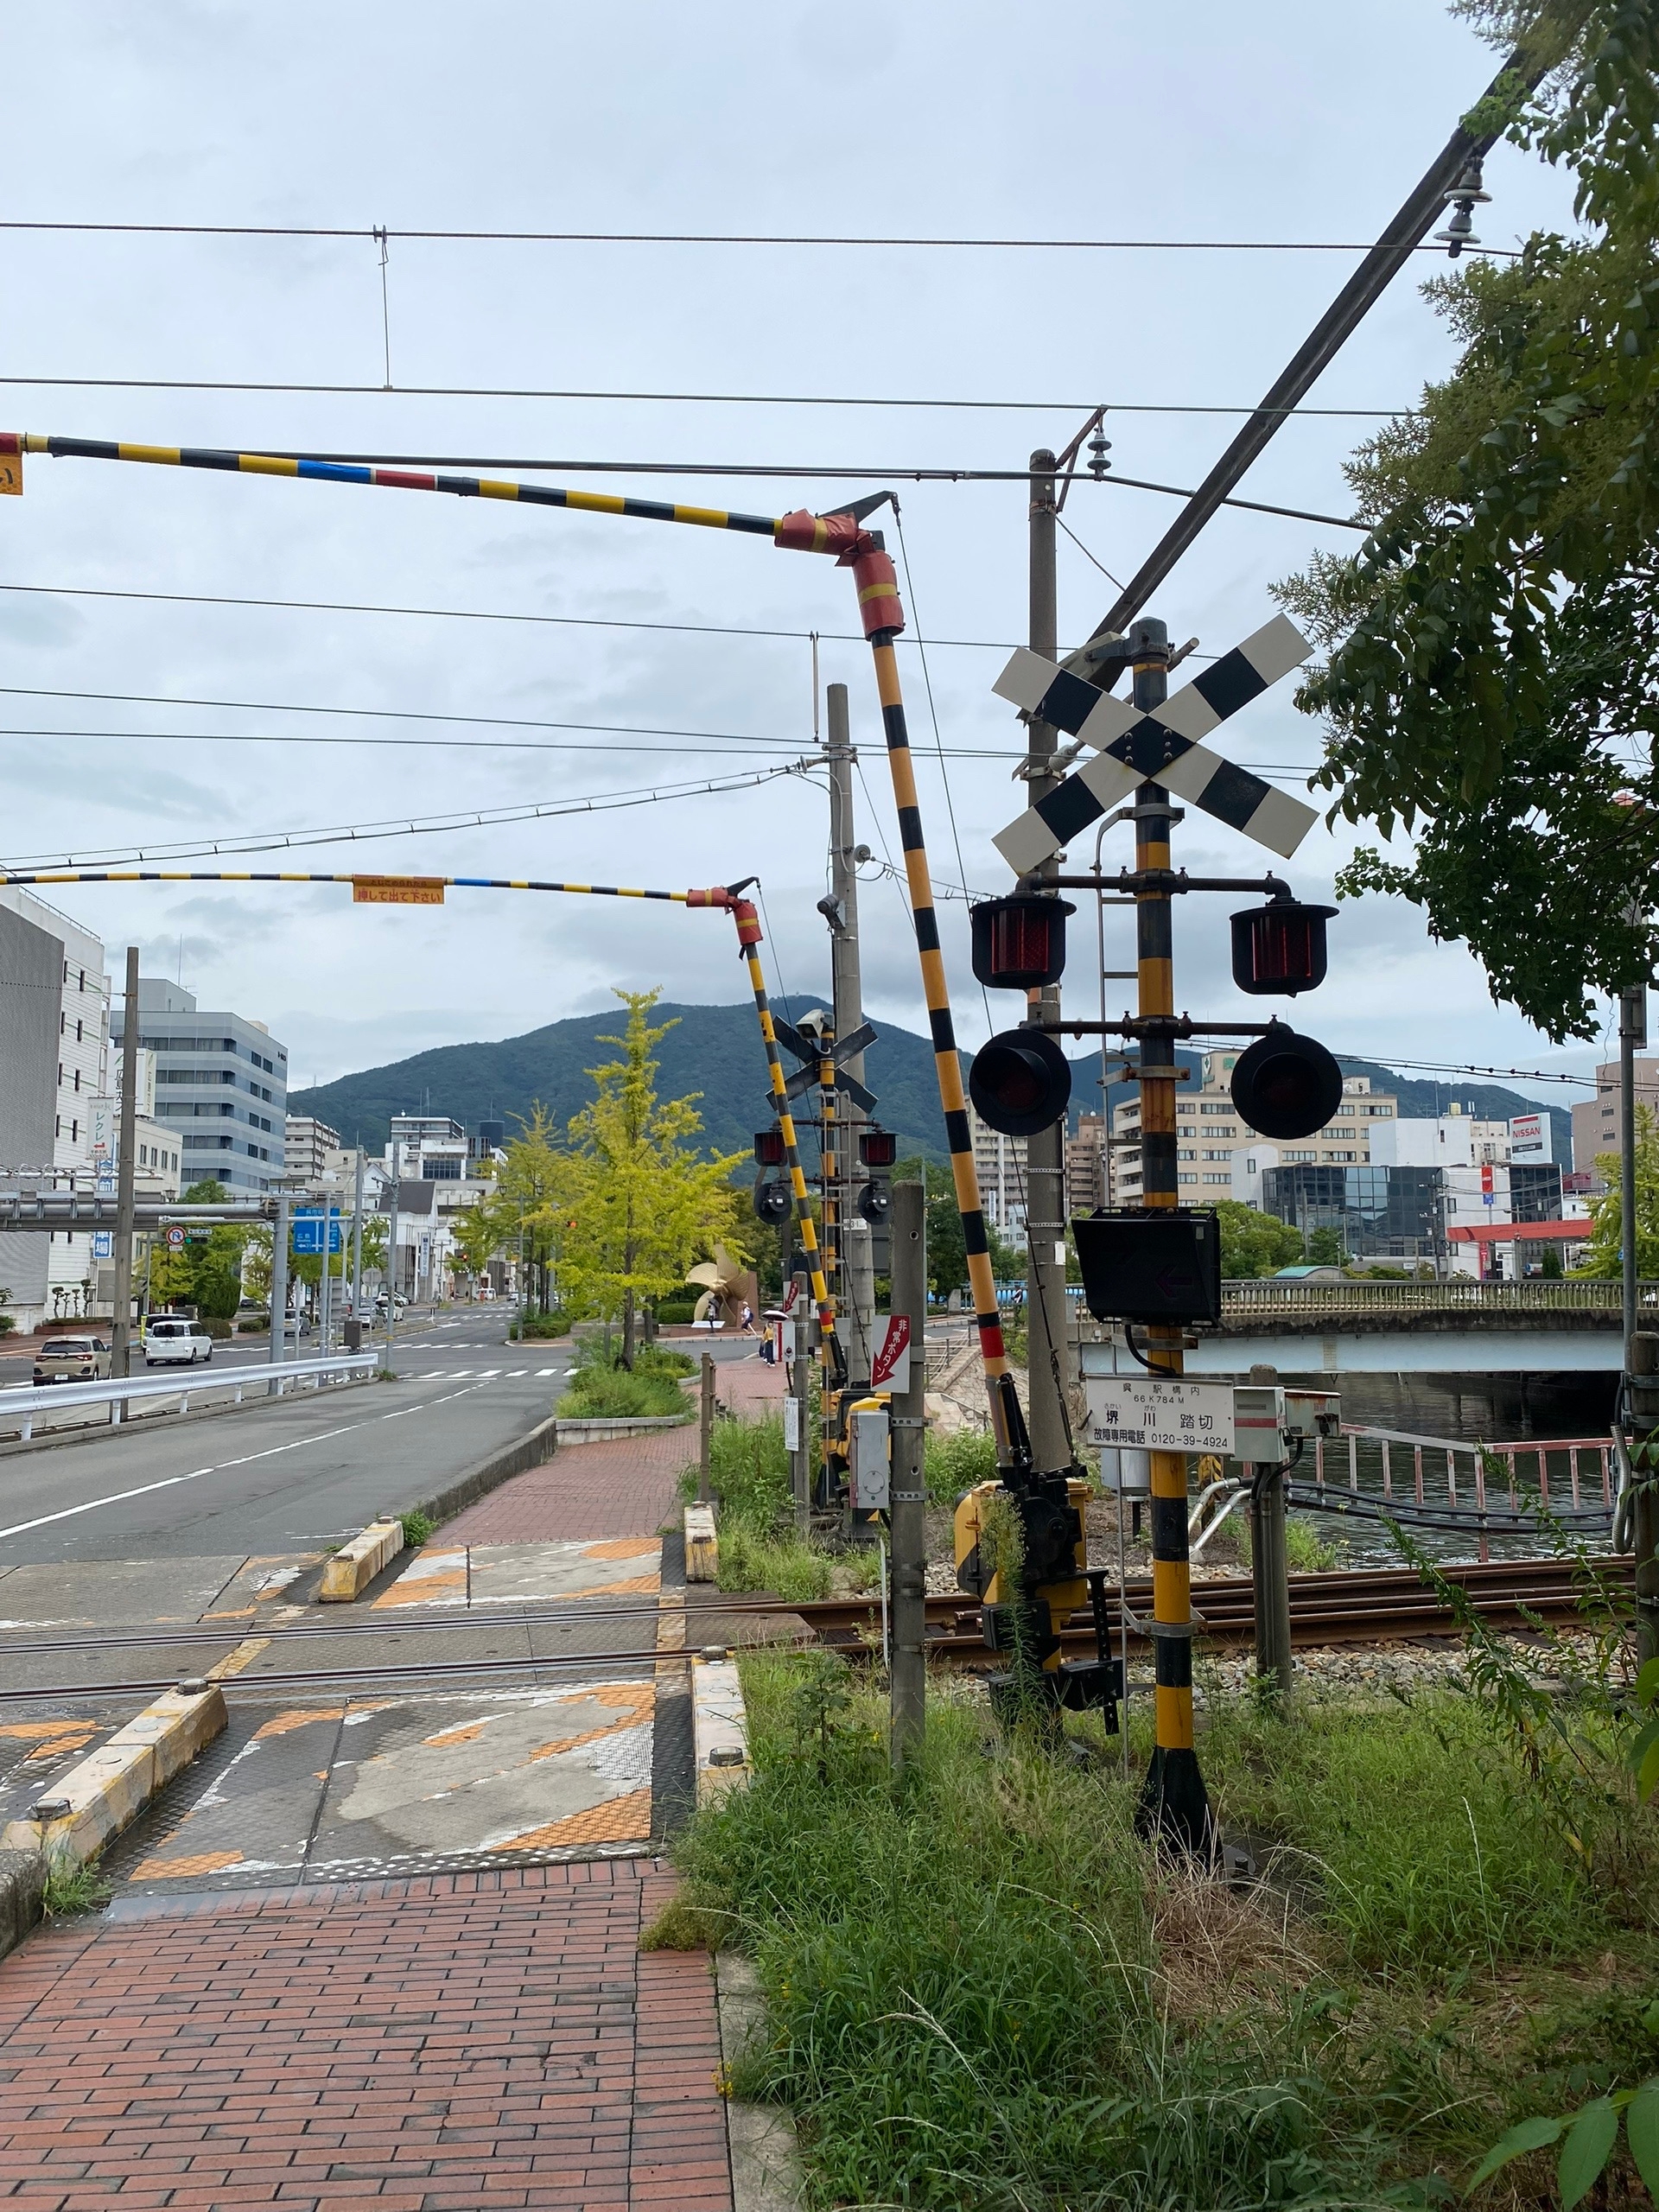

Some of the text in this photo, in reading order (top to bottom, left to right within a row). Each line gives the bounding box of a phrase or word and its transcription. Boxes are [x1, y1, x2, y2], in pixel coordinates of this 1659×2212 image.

[358, 888, 441, 903] 押して出て下さい
[1513, 1127, 1541, 1139] NISSAN
[876, 1319, 907, 1378] 非常ボタン
[1094, 1427, 1228, 1448] 故障専用電話 0120-39-4924
